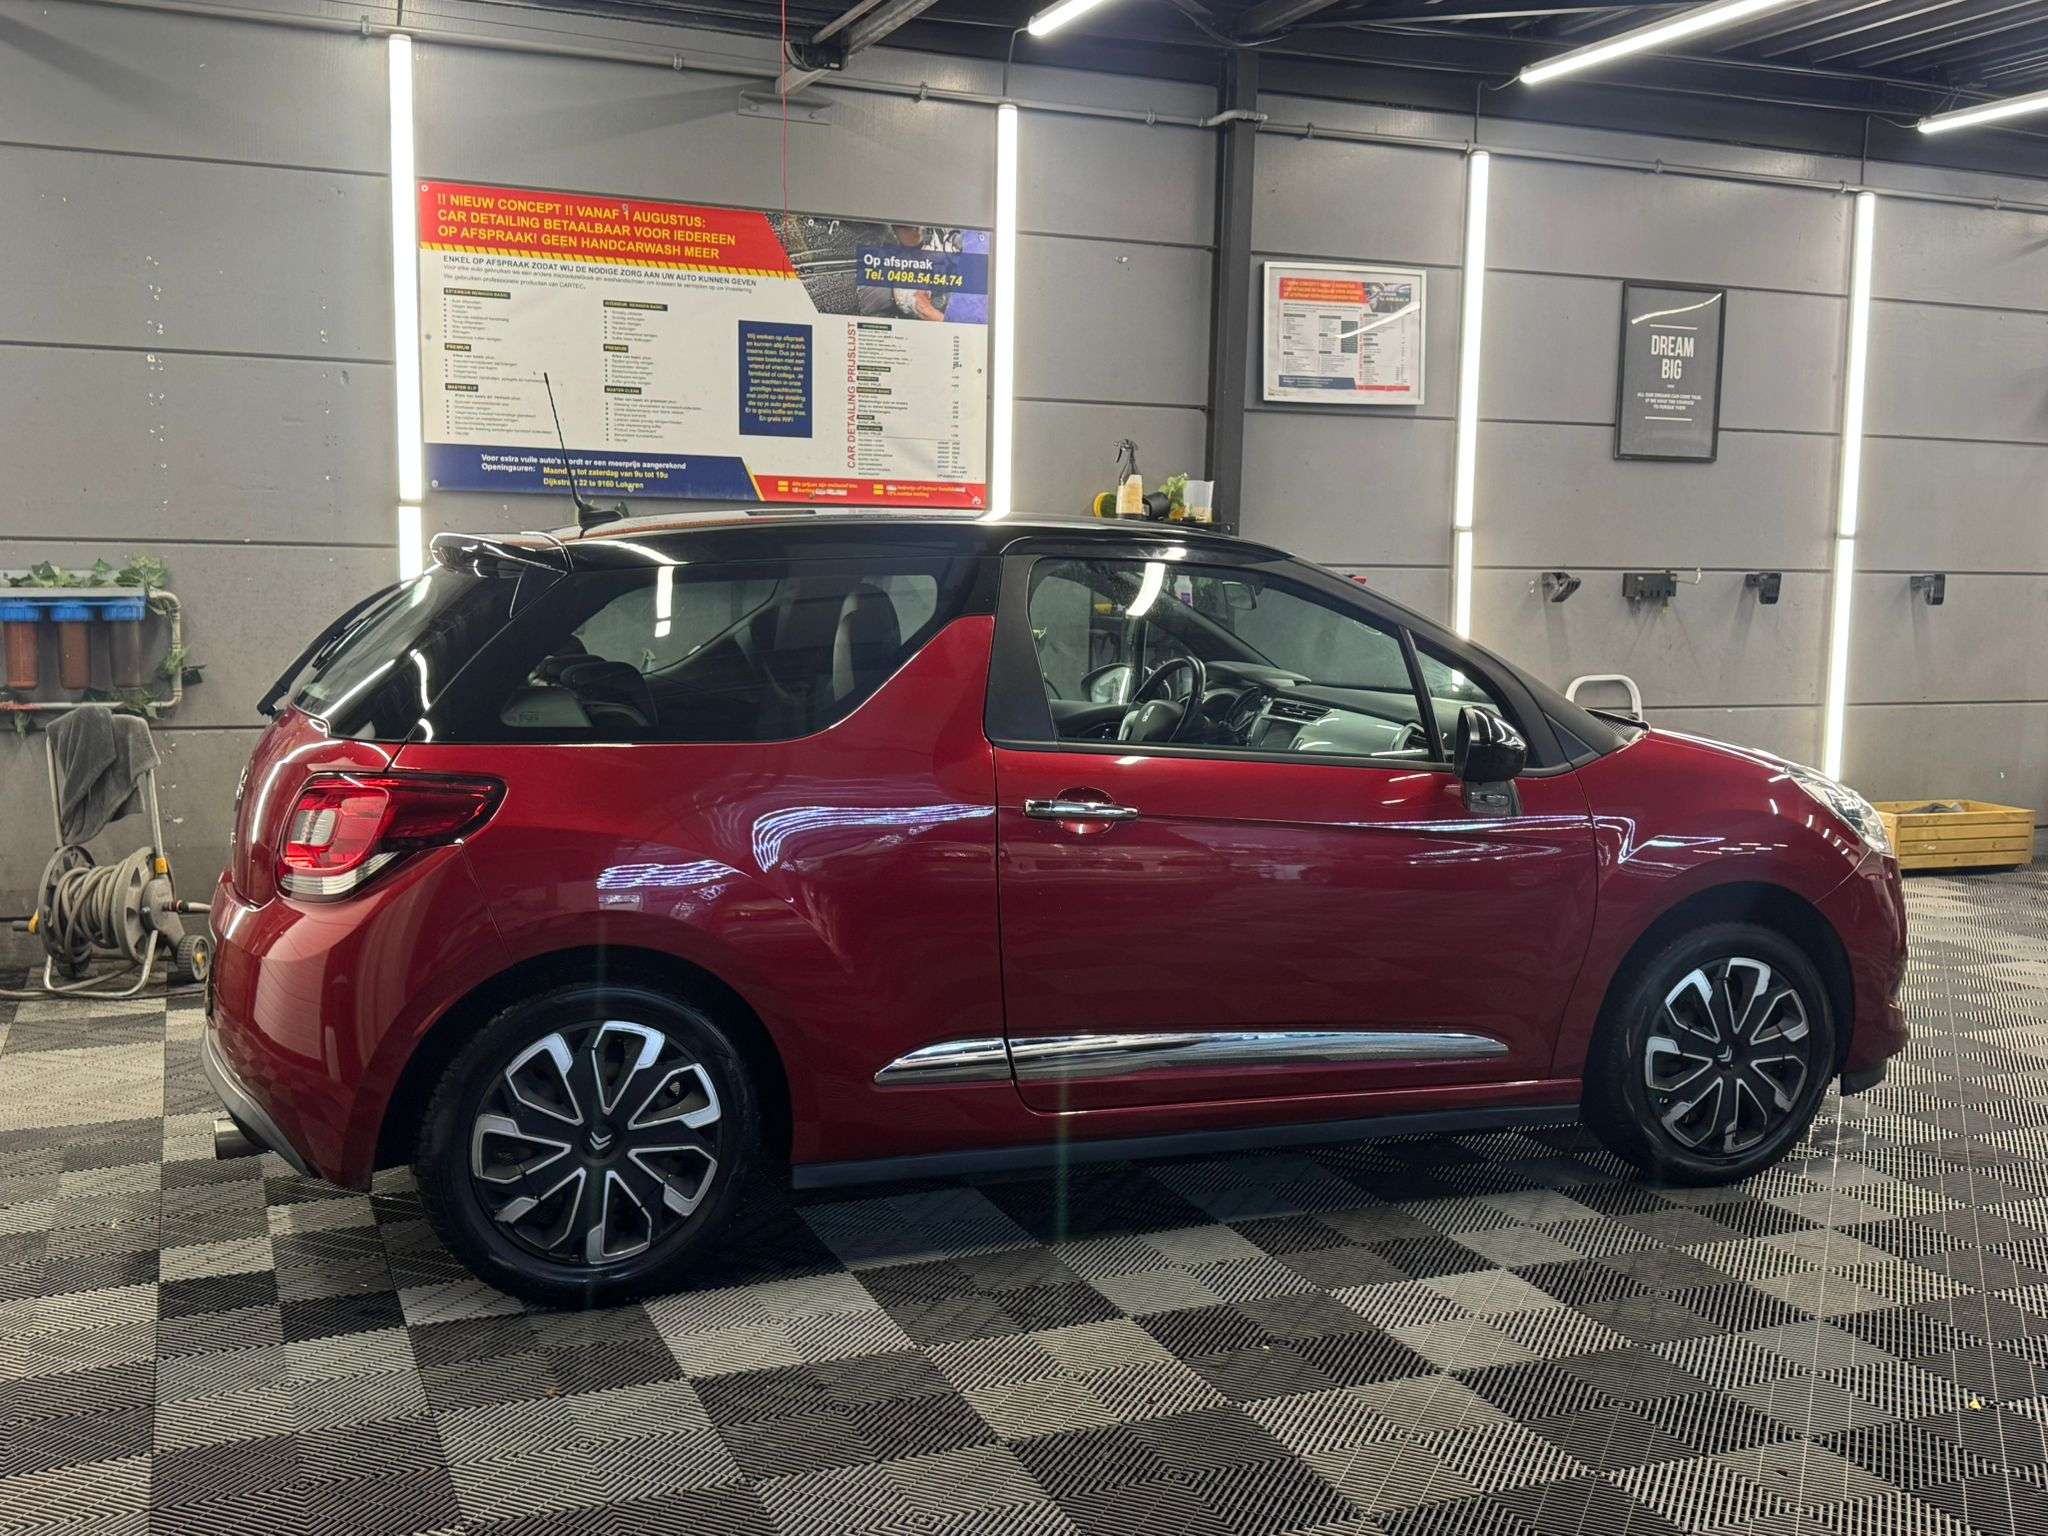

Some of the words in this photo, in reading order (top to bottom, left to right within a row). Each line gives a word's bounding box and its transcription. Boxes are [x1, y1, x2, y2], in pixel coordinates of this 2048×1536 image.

[450, 194, 494, 209] NIEUW
[497, 198, 562, 215] CONCEPT
[576, 205, 620, 220] VANAF
[633, 211, 706, 229] AUGUSTUS:
[437, 209, 467, 223] CAR
[470, 212, 540, 229] DETAILING
[543, 218, 631, 237] BETAALBAAR
[634, 226, 671, 240] VOOR
[673, 229, 736, 246] IEDEREEN
[437, 225, 458, 238] OP
[460, 227, 538, 244] AFSPRAAK!
[541, 233, 577, 248] GEEN
[581, 237, 681, 256] HANDCARWASH
[684, 246, 720, 259] MEER
[444, 255, 470, 264] ENKEL
[472, 257, 484, 265] OP
[486, 258, 530, 268] AFSPRAAK
[532, 262, 558, 270] ZODAT
[588, 266, 618, 275] NODIGE
[620, 269, 642, 277] ZORG
[676, 274, 696, 282] AUTO
[698, 275, 730, 284] KUNNEN
[732, 278, 756, 286] GEVEN
[863, 254, 881, 268] Op
[883, 255, 933, 271] afspraak
[864, 268, 884, 281] Tel.
[887, 271, 963, 287] 0498.54.54.74
[847, 322, 856, 382] PRIJSLIJST
[1650, 334, 1695, 358] DREAM
[1661, 358, 1683, 380] BIG
[847, 386, 856, 443] DETAILING
[608, 460, 640, 469] meerprijs
[642, 462, 686, 470] aangerekend
[847, 447, 856, 469] CAR
[544, 466, 576, 476] Maandg
[588, 468, 618, 478] zaterdag
